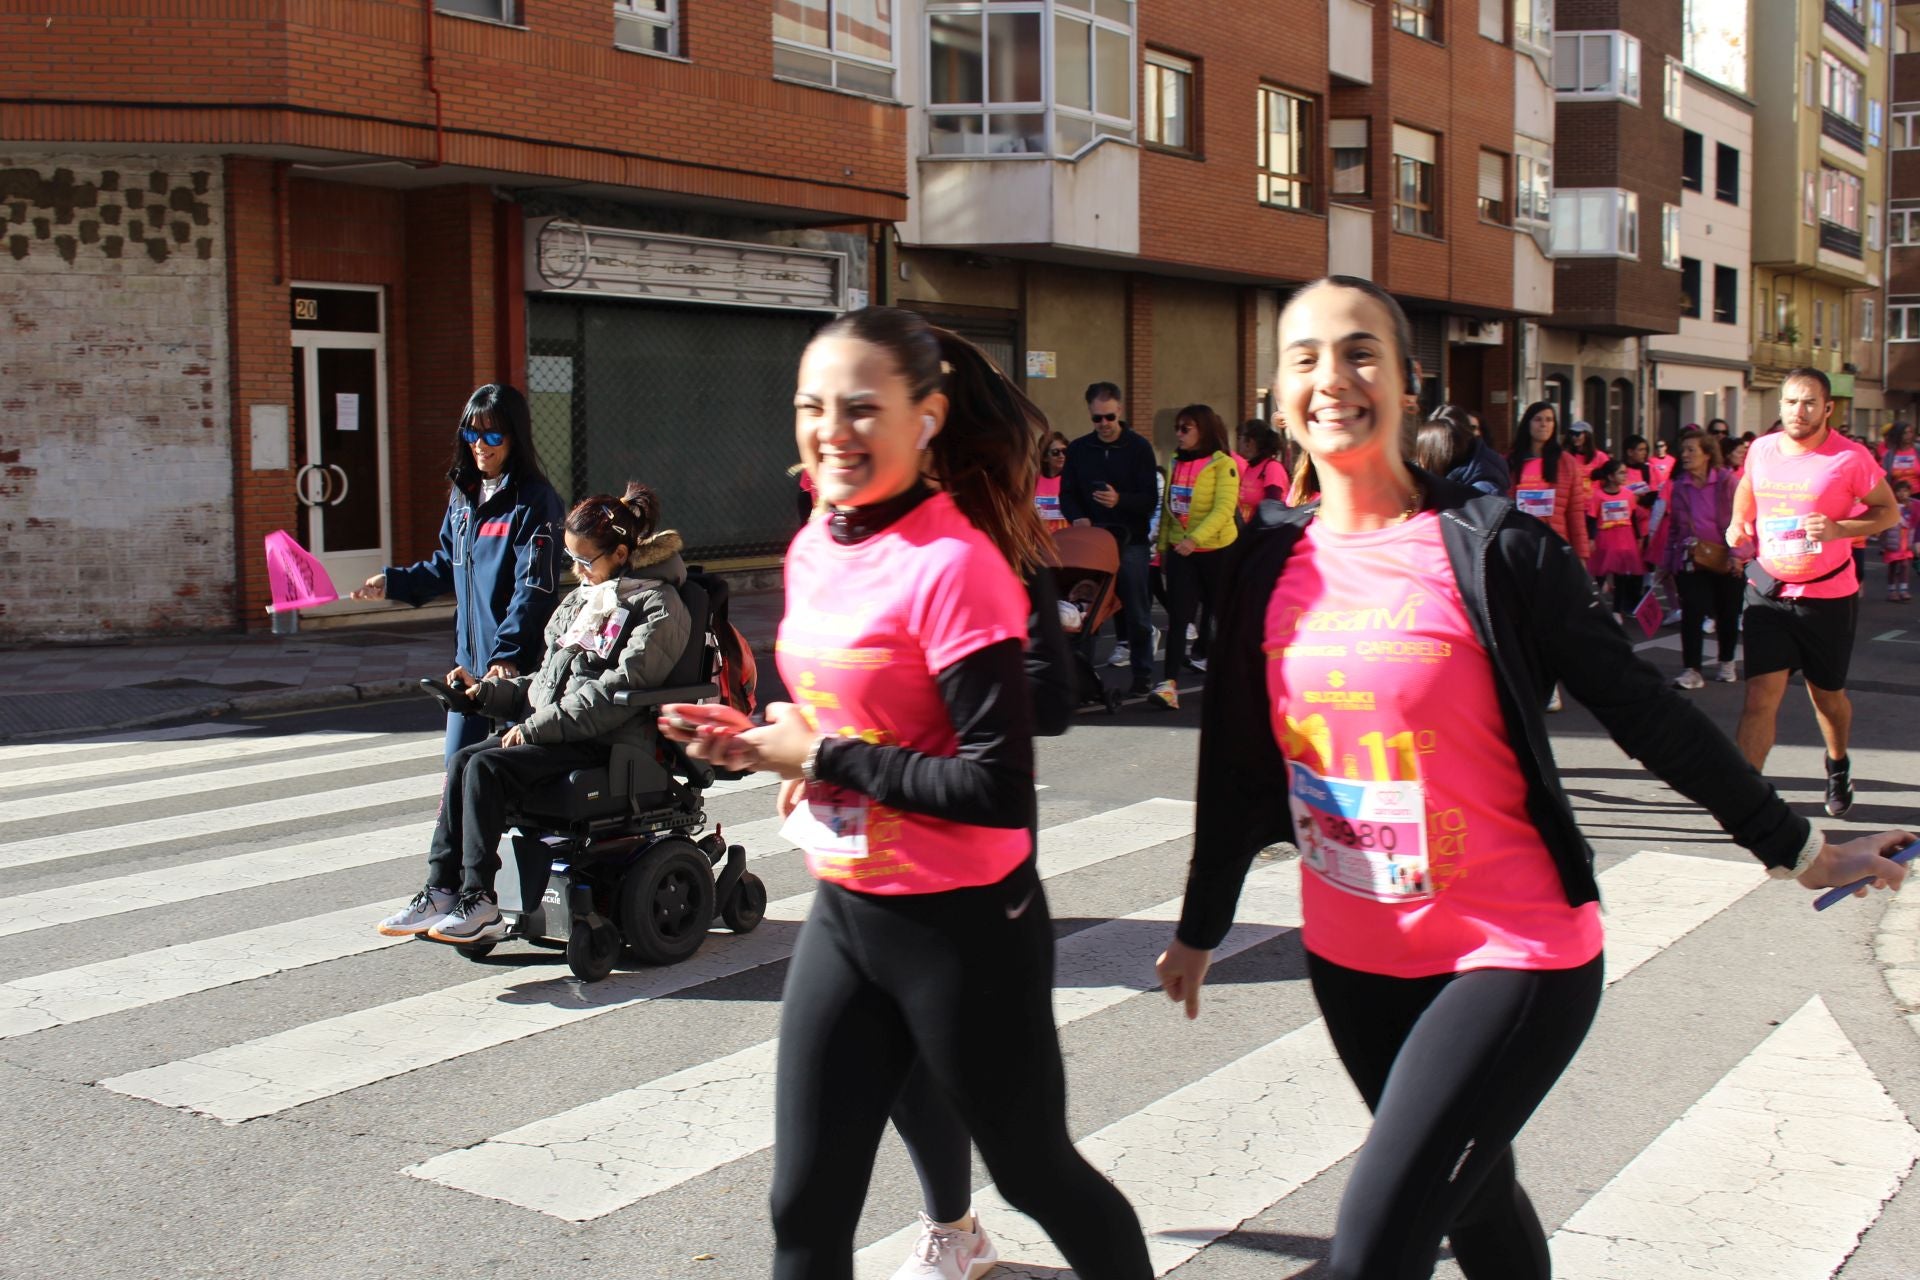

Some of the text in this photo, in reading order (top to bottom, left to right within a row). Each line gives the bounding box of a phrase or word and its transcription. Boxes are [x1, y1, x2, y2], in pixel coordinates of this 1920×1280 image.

[297, 301, 316, 318] 20
[1356, 641, 1452, 657] CAROBELS
[1303, 691, 1376, 703] SUZUKI
